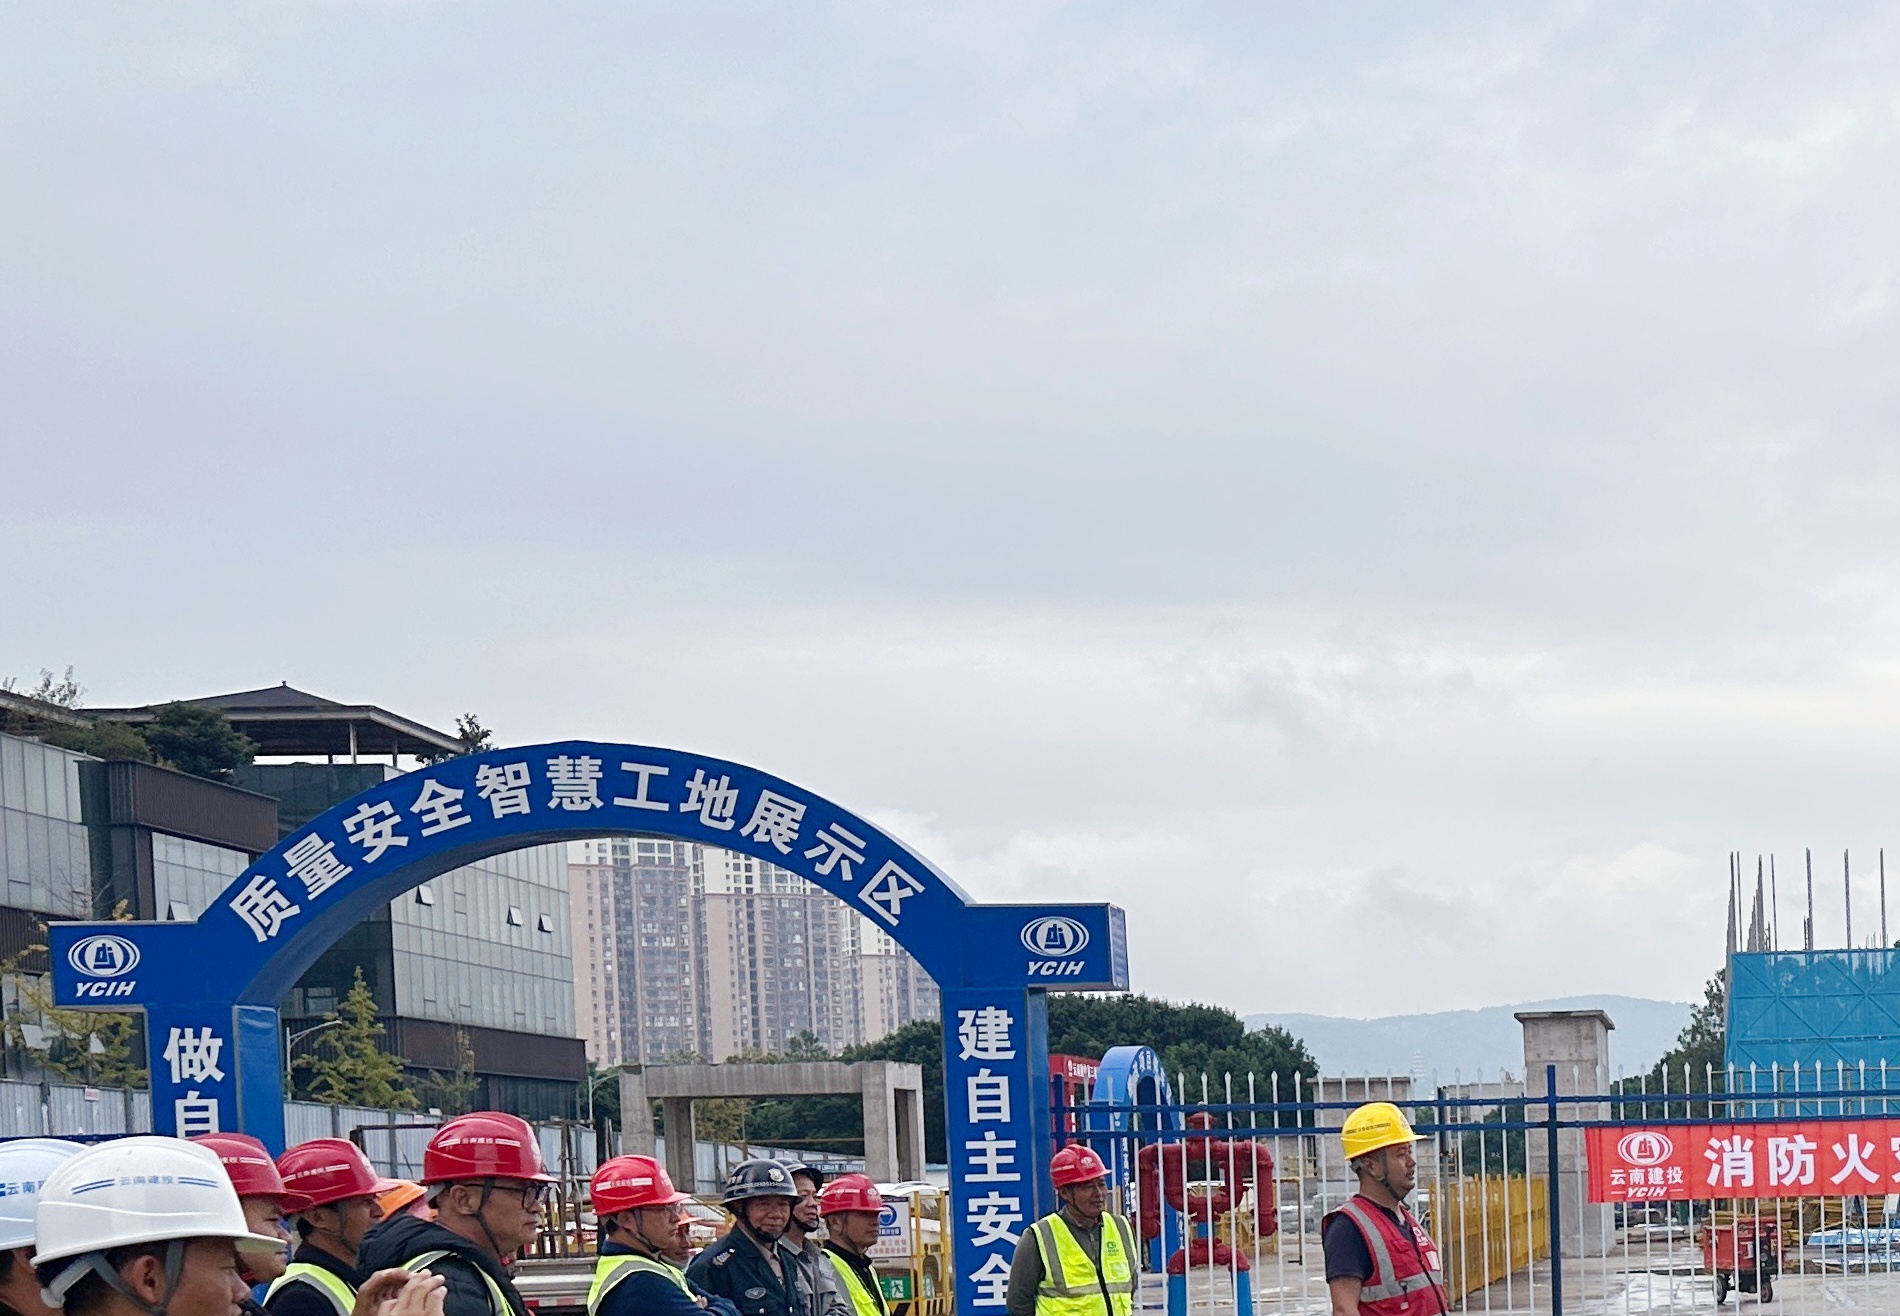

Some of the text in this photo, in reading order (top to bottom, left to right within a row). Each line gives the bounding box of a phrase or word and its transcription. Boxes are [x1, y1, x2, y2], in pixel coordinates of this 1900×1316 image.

[229, 755, 925, 943] 质量安全智慧工地展示区
[1027, 960, 1086, 977] YCIH
[74, 980, 137, 998] YCIH
[1609, 1166, 1684, 1187] 云南建投
[1627, 1185, 1668, 1198] YCIH
